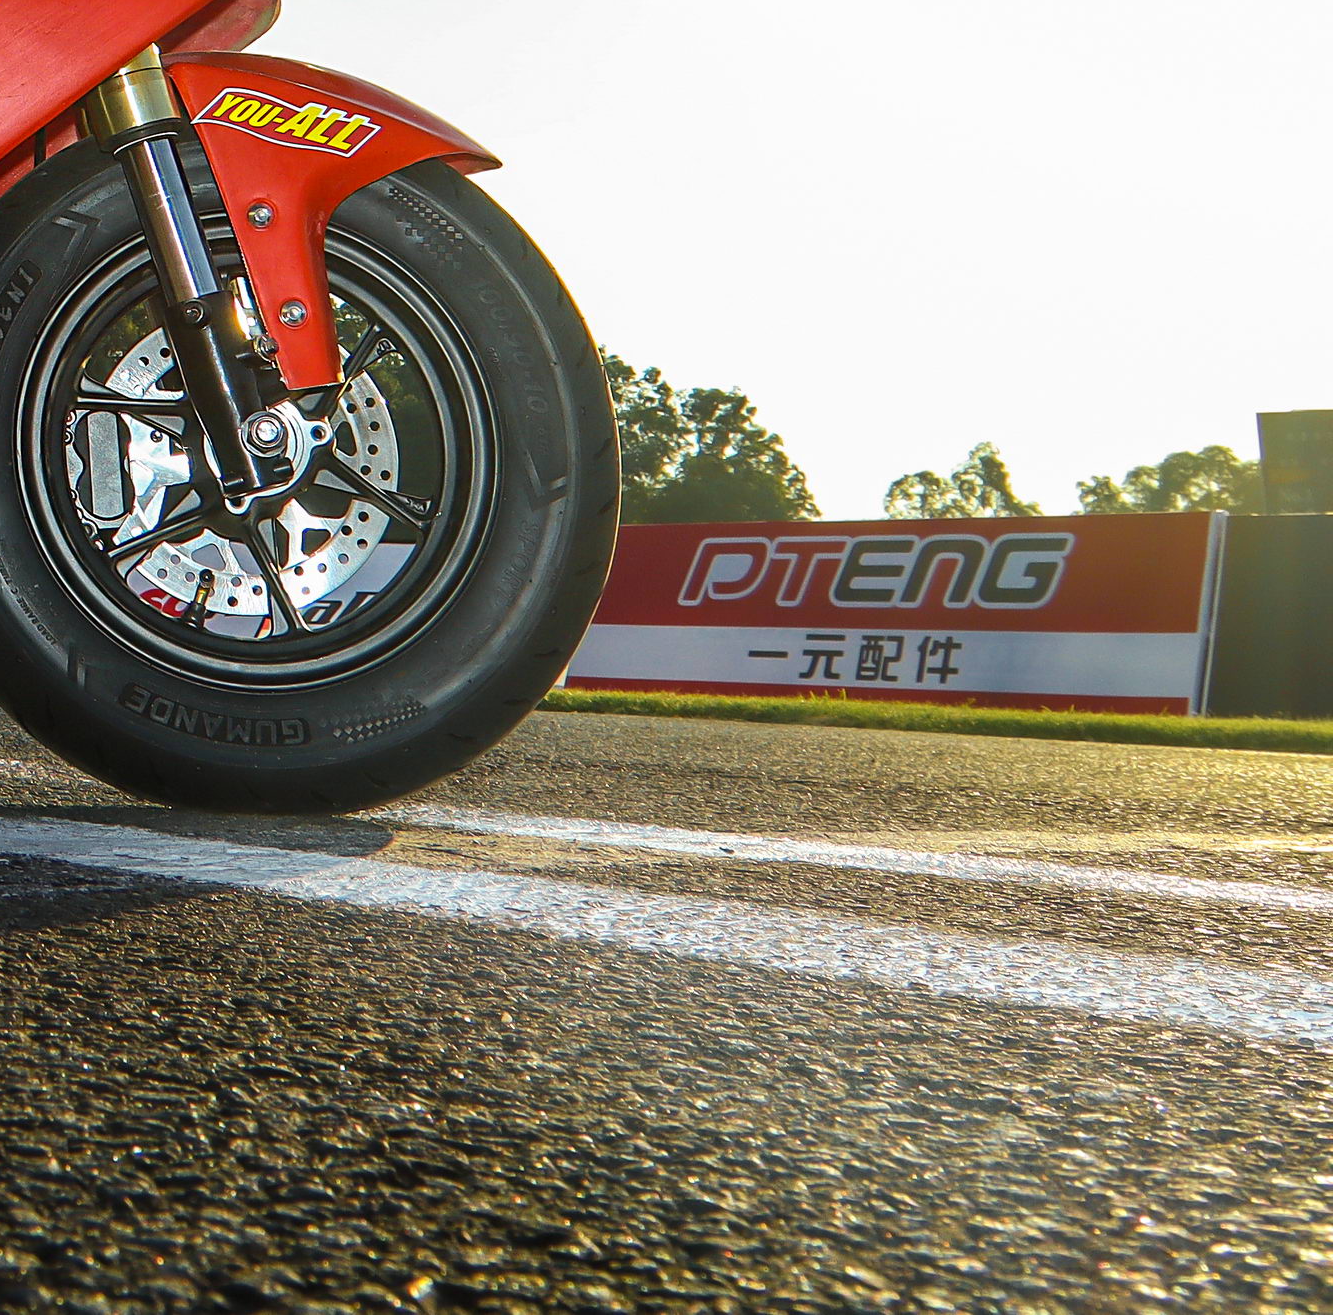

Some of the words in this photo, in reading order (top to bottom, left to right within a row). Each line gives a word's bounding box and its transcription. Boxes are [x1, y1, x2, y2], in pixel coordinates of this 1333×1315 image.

[212, 83, 365, 151] YOU-ALL
[677, 532, 1075, 611] PTENG
[746, 633, 964, 685] 一元配件
[124, 686, 306, 746] GUMANDE
